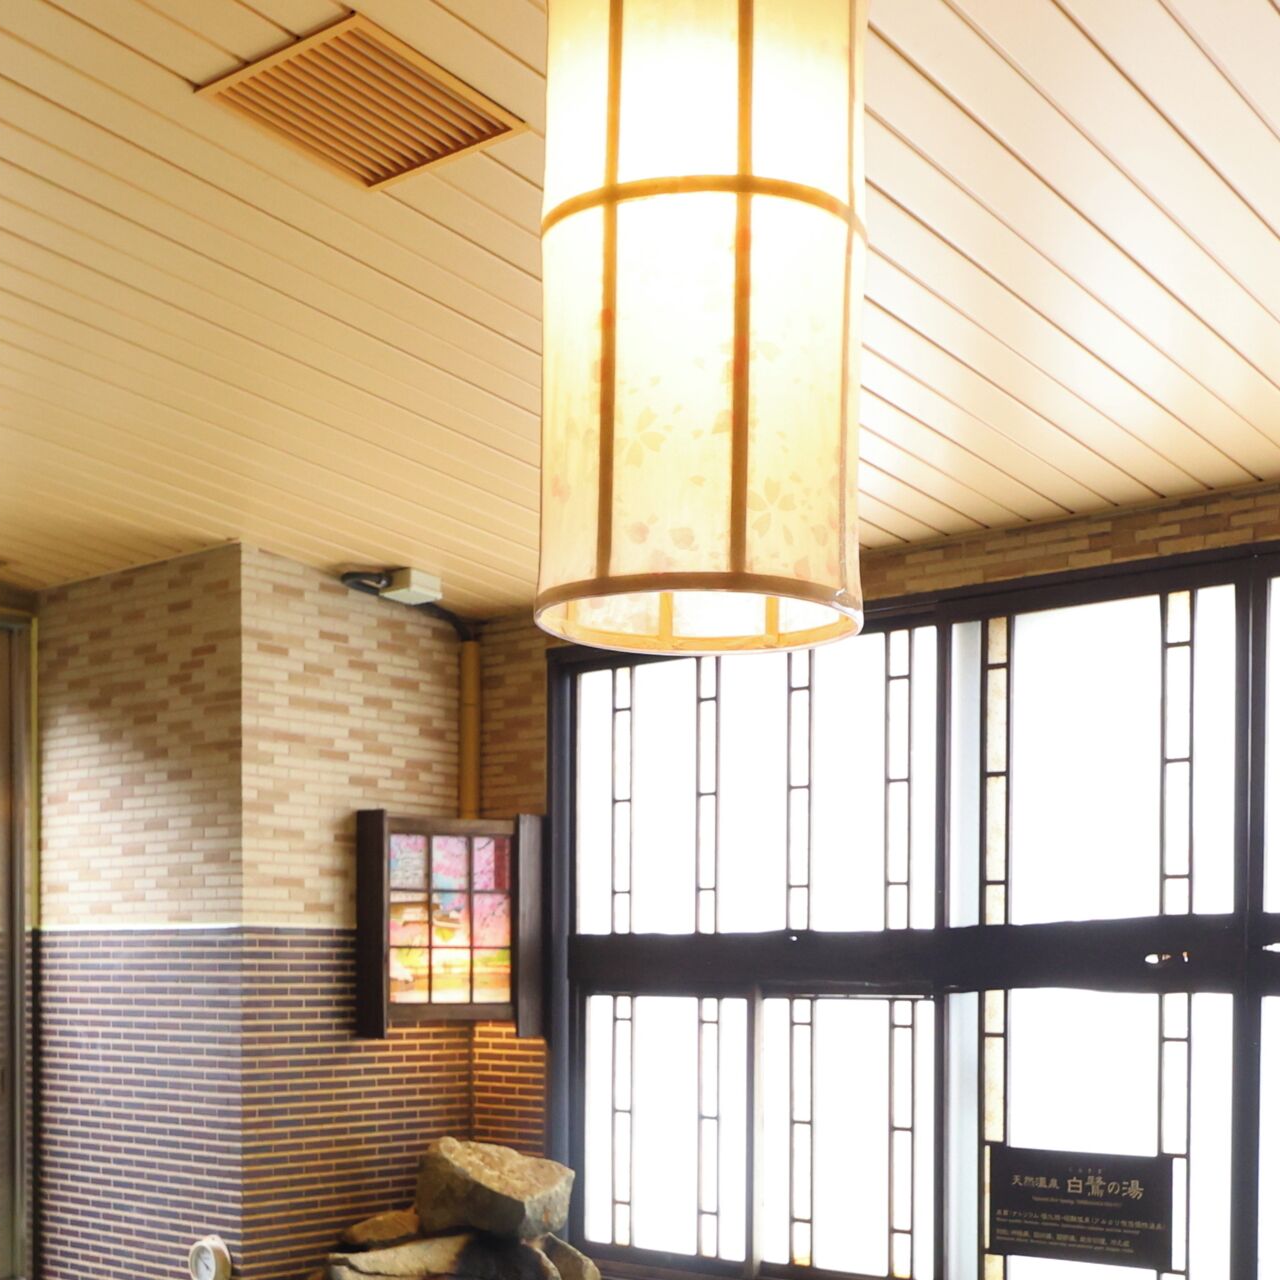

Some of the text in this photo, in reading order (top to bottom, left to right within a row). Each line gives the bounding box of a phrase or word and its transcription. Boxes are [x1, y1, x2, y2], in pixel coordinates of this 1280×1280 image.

[1012, 1174, 1144, 1200] 天然温泉 白鷺の湯
